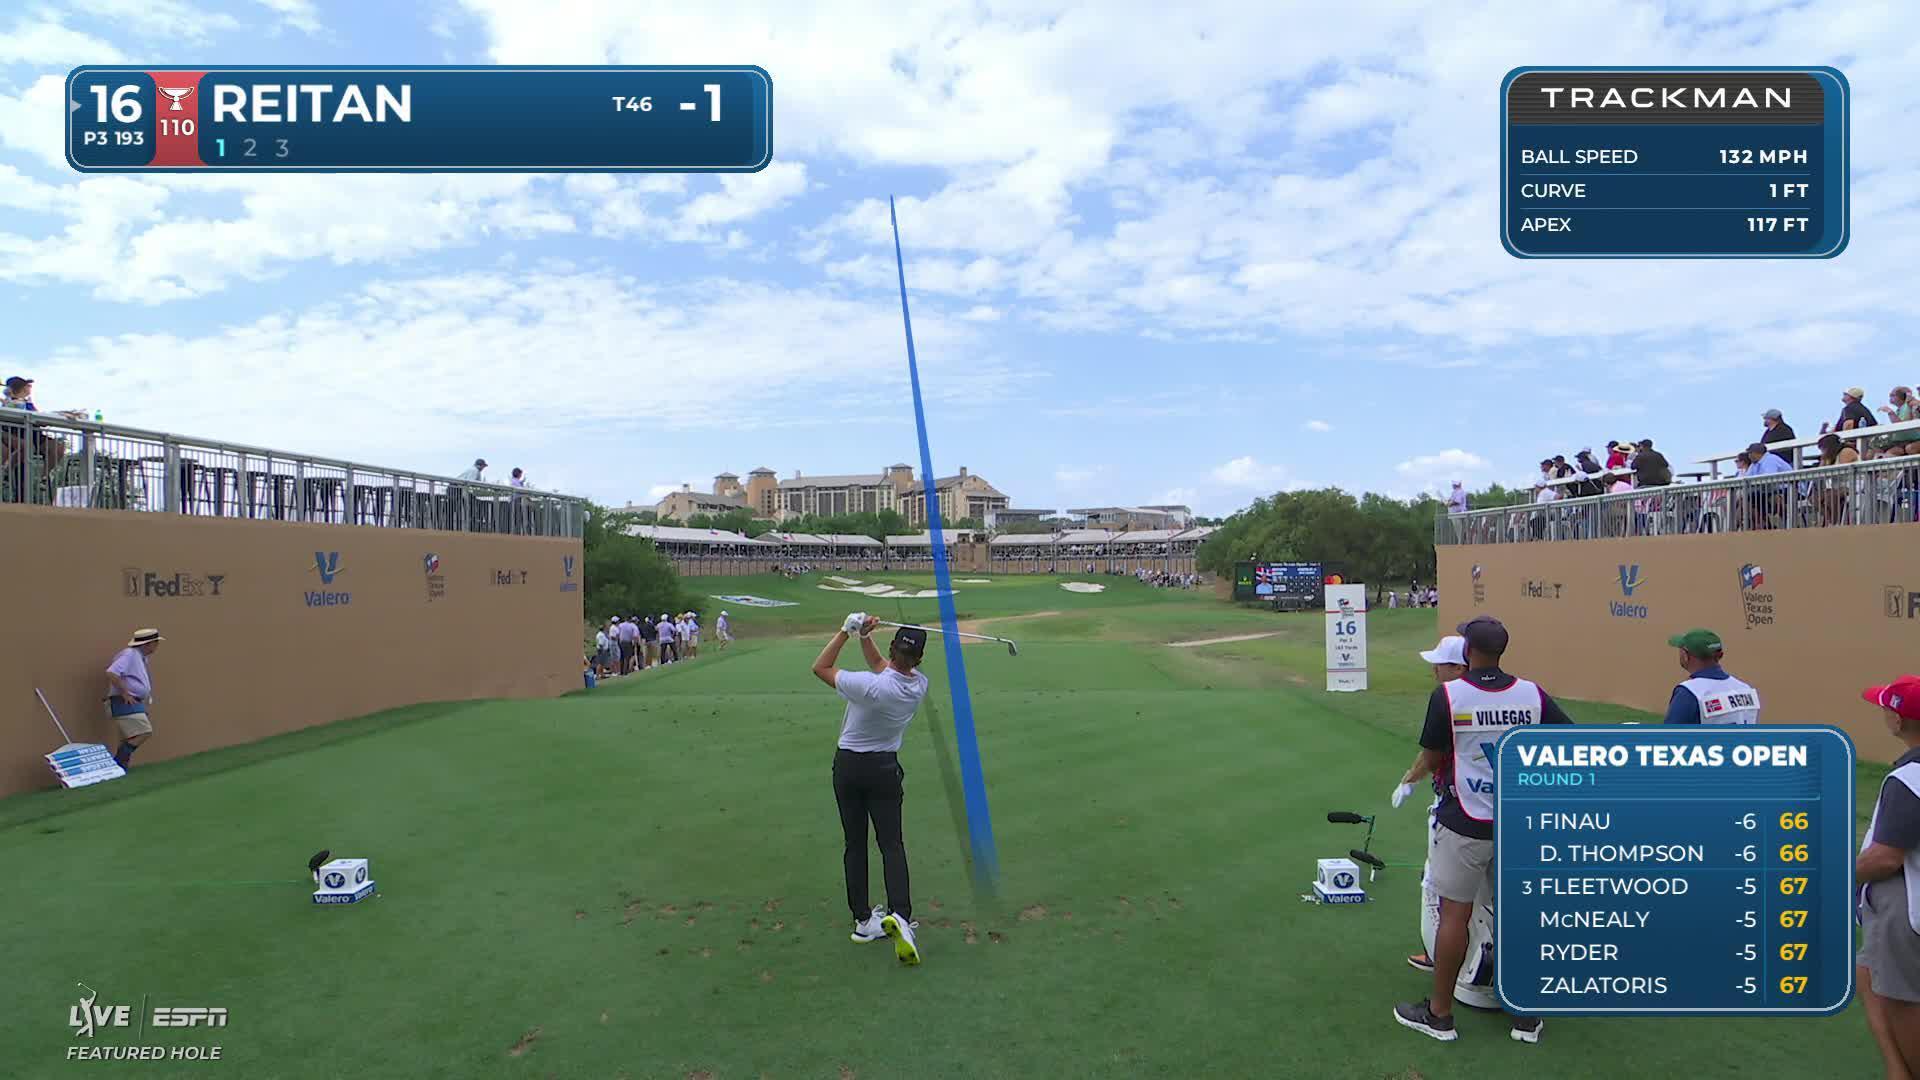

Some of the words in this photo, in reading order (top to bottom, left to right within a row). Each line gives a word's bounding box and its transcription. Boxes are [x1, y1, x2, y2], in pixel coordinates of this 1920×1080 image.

[144, 572, 204, 597] FedEx
[304, 591, 350, 608] Valero
[1744, 591, 1773, 603] Valero
[1610, 600, 1648, 619] Valero
[1746, 603, 1773, 614] Texas
[1335, 620, 1357, 636] 16
[1748, 614, 1774, 627] Open
[1728, 693, 1755, 708] REITAN
[1476, 710, 1532, 726] VILLEGAS
[314, 895, 350, 904] Valero
[1327, 894, 1362, 904] Valero
